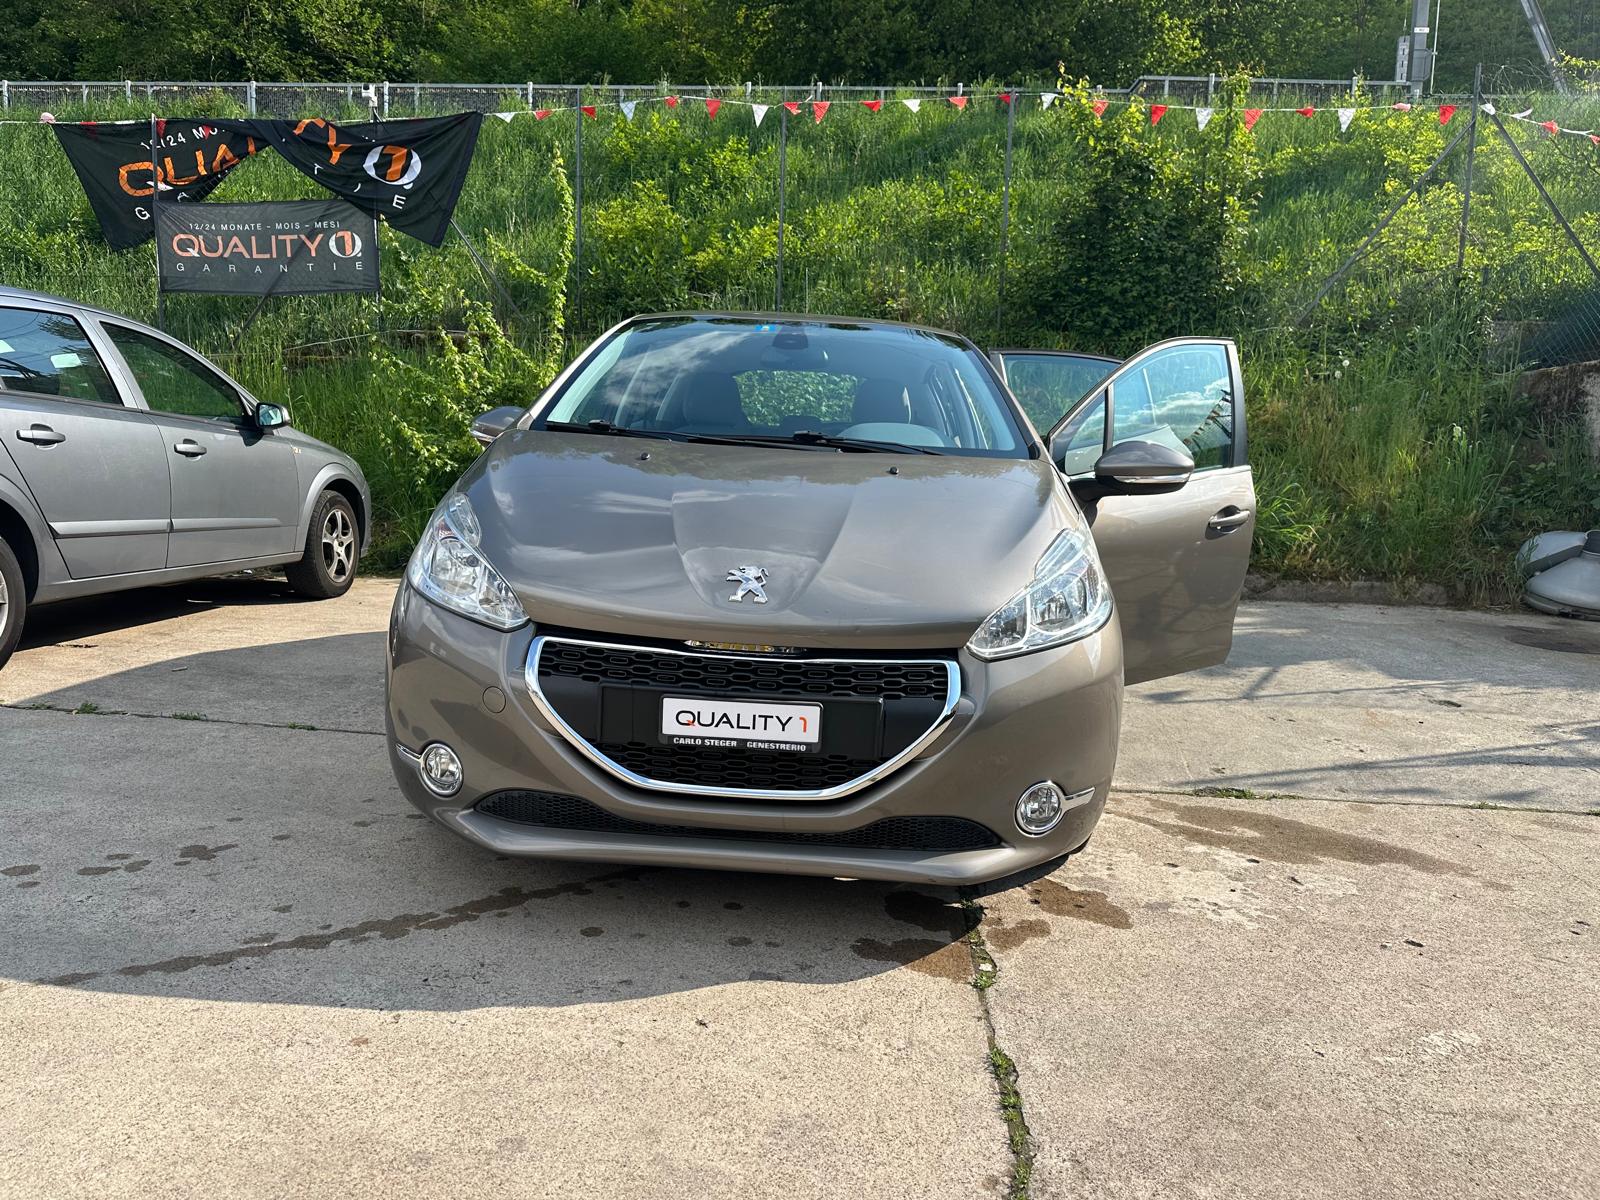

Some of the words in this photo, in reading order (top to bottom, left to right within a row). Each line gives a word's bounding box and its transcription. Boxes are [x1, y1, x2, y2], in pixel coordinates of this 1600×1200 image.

[189, 223, 216, 231] 12/24
[220, 223, 263, 231] MONATE
[275, 222, 301, 230] MOIS
[314, 221, 340, 229] MESI
[172, 233, 325, 259] QUALITY
[176, 261, 363, 274] GARANTIE
[675, 710, 793, 732] QUALITY
[673, 737, 702, 746] CARLO
[704, 739, 737, 747] STEGER
[746, 741, 807, 752] GENESTRERIO
